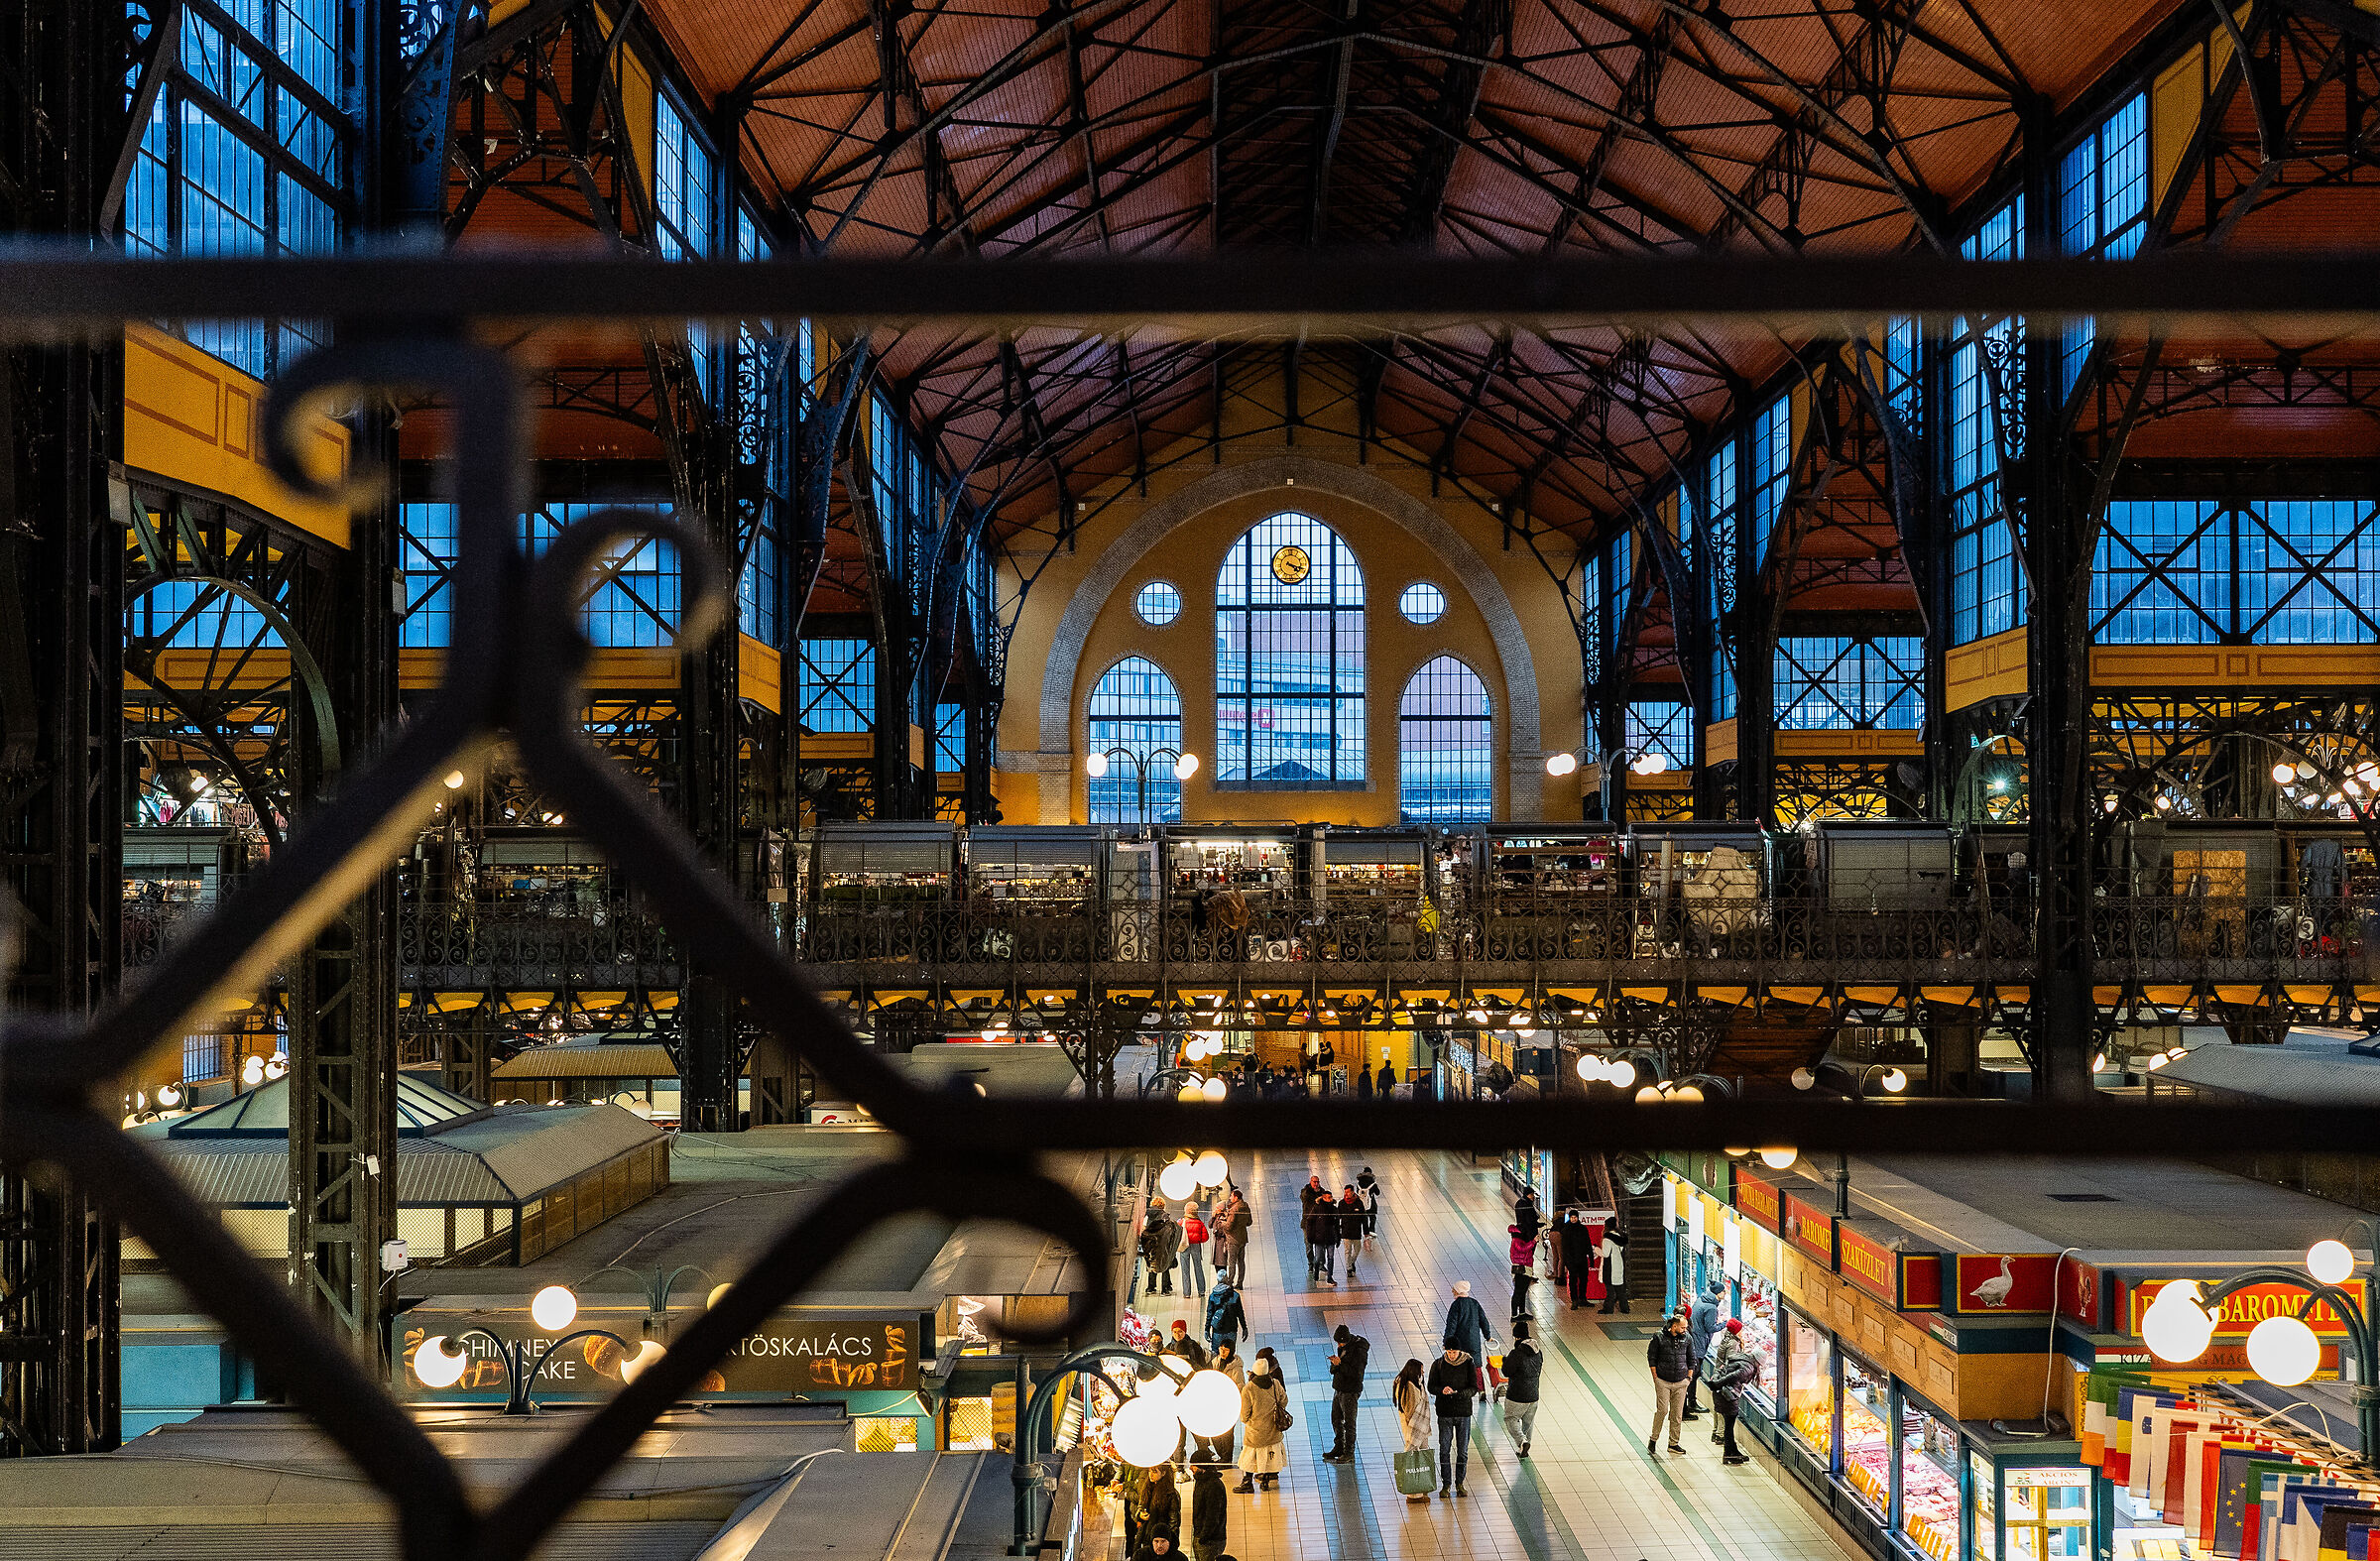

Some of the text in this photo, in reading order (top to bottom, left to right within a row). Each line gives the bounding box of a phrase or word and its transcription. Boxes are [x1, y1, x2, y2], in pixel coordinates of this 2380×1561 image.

[1802, 1215, 1832, 1254] BAROMFI
[1842, 1239, 1886, 1286] SZAKÜZLET
[457, 1339, 560, 1358] CHIMNEY
[727, 1333, 872, 1356] TÖSKALÁCS
[520, 1362, 576, 1380] CAKE
